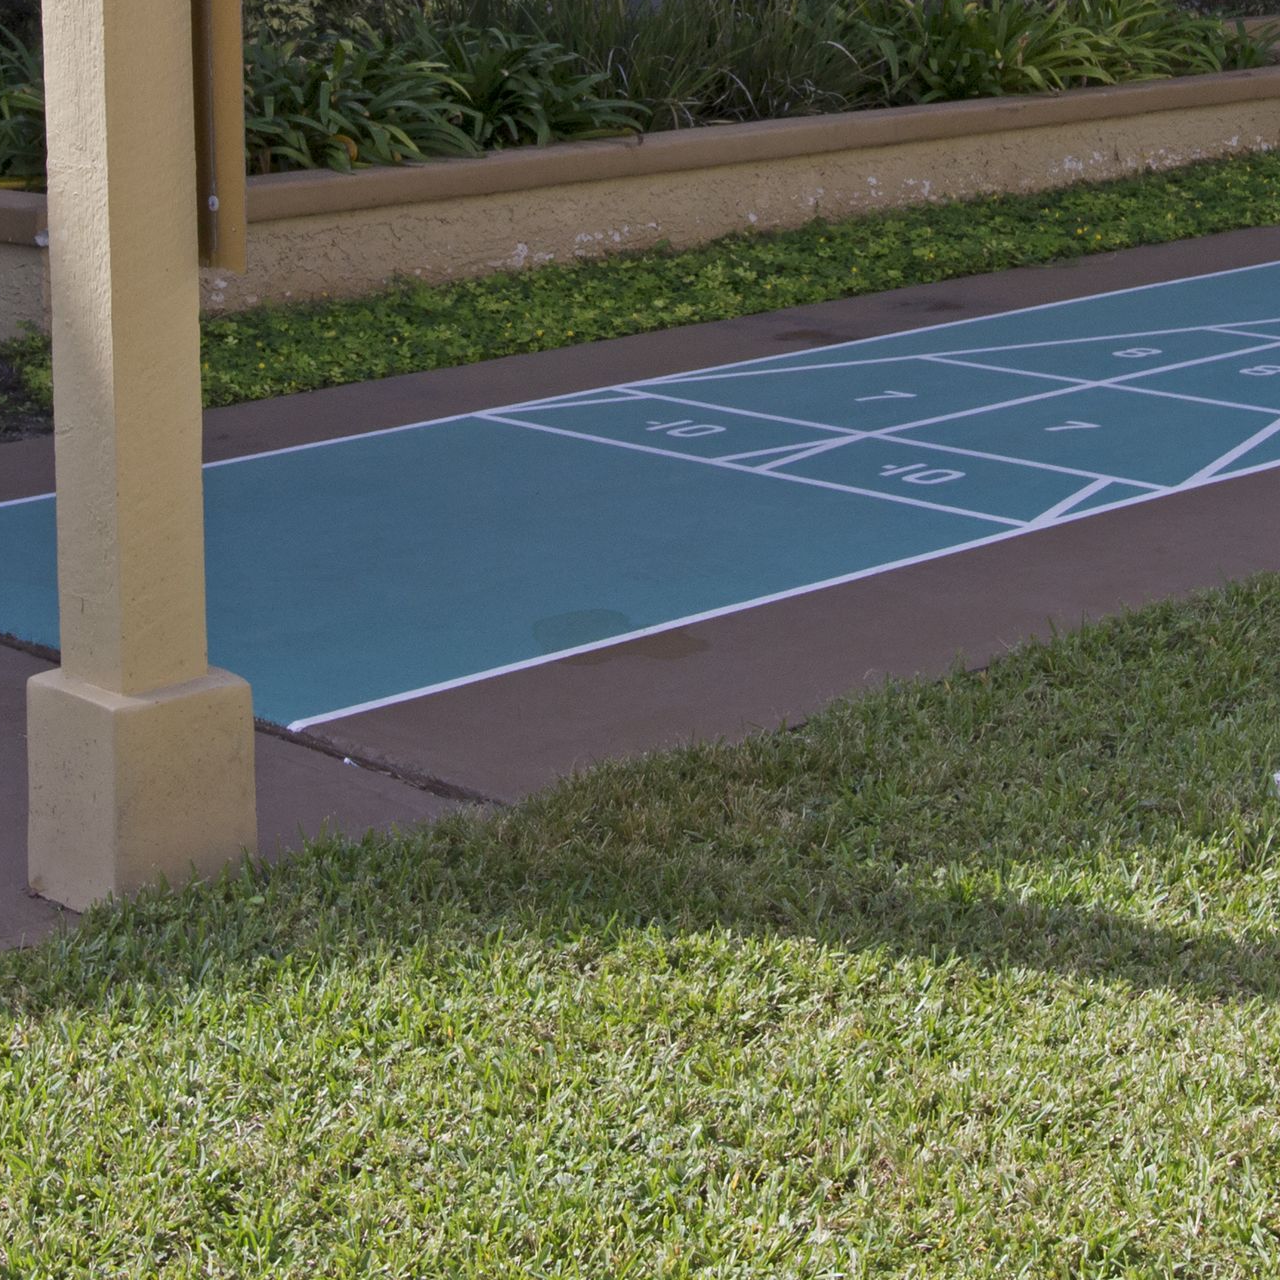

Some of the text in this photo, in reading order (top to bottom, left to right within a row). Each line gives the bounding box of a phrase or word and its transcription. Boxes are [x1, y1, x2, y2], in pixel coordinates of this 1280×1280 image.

[1111, 347, 1163, 359] 8
[854, 389, 918, 402] 7
[1044, 420, 1101, 432] 7
